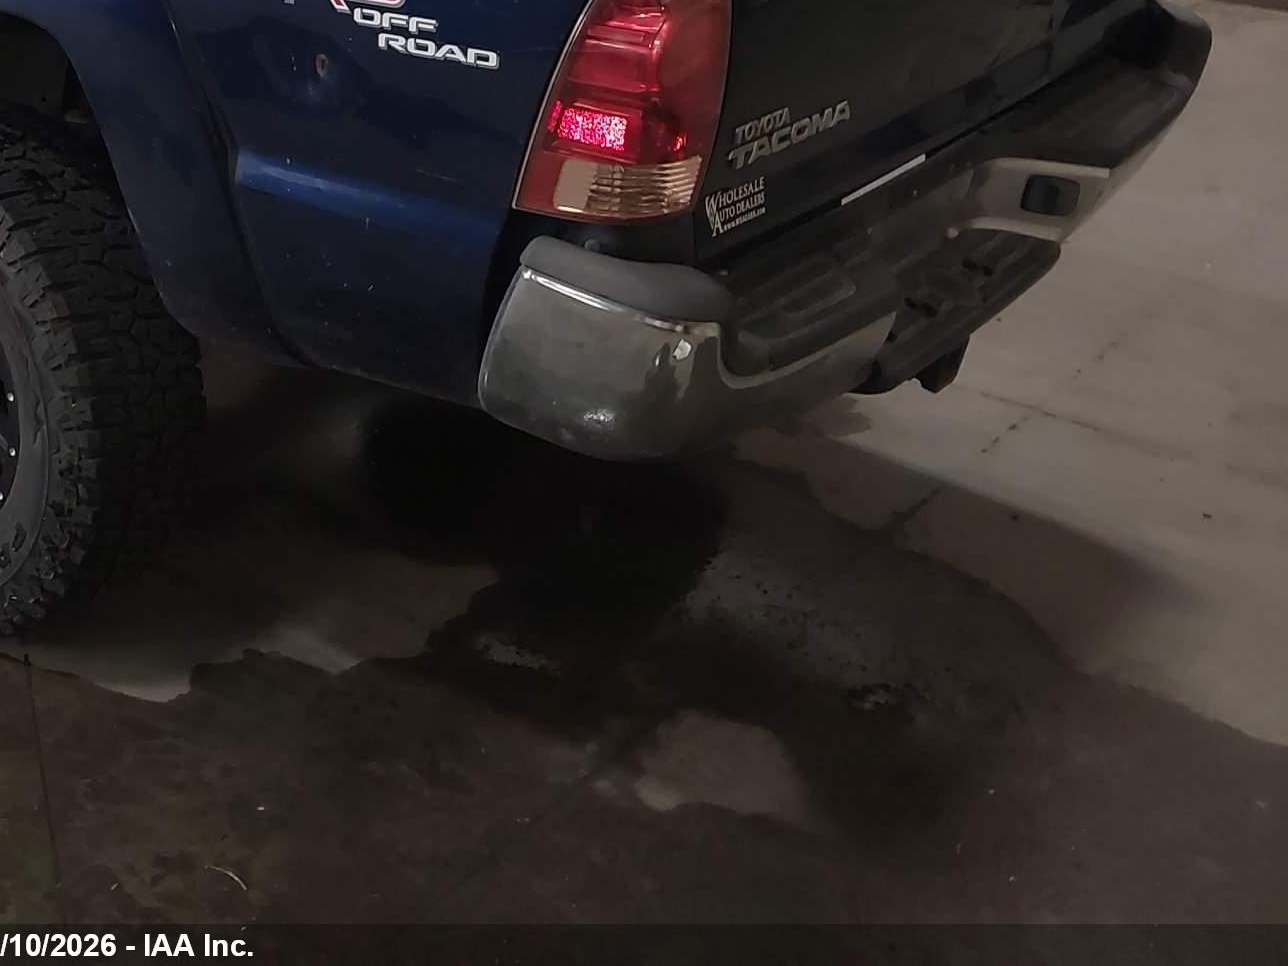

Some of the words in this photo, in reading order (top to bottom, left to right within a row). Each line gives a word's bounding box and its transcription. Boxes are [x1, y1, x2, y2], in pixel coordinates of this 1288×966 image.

[353, 7, 439, 34] OFF
[378, 32, 500, 70] ROAD
[728, 100, 851, 170] TACOMA
[735, 107, 791, 144] TOYOTA
[705, 176, 765, 218] WHOLESALE
[712, 206, 736, 237] AUTO
[736, 191, 765, 214] DEALERS
